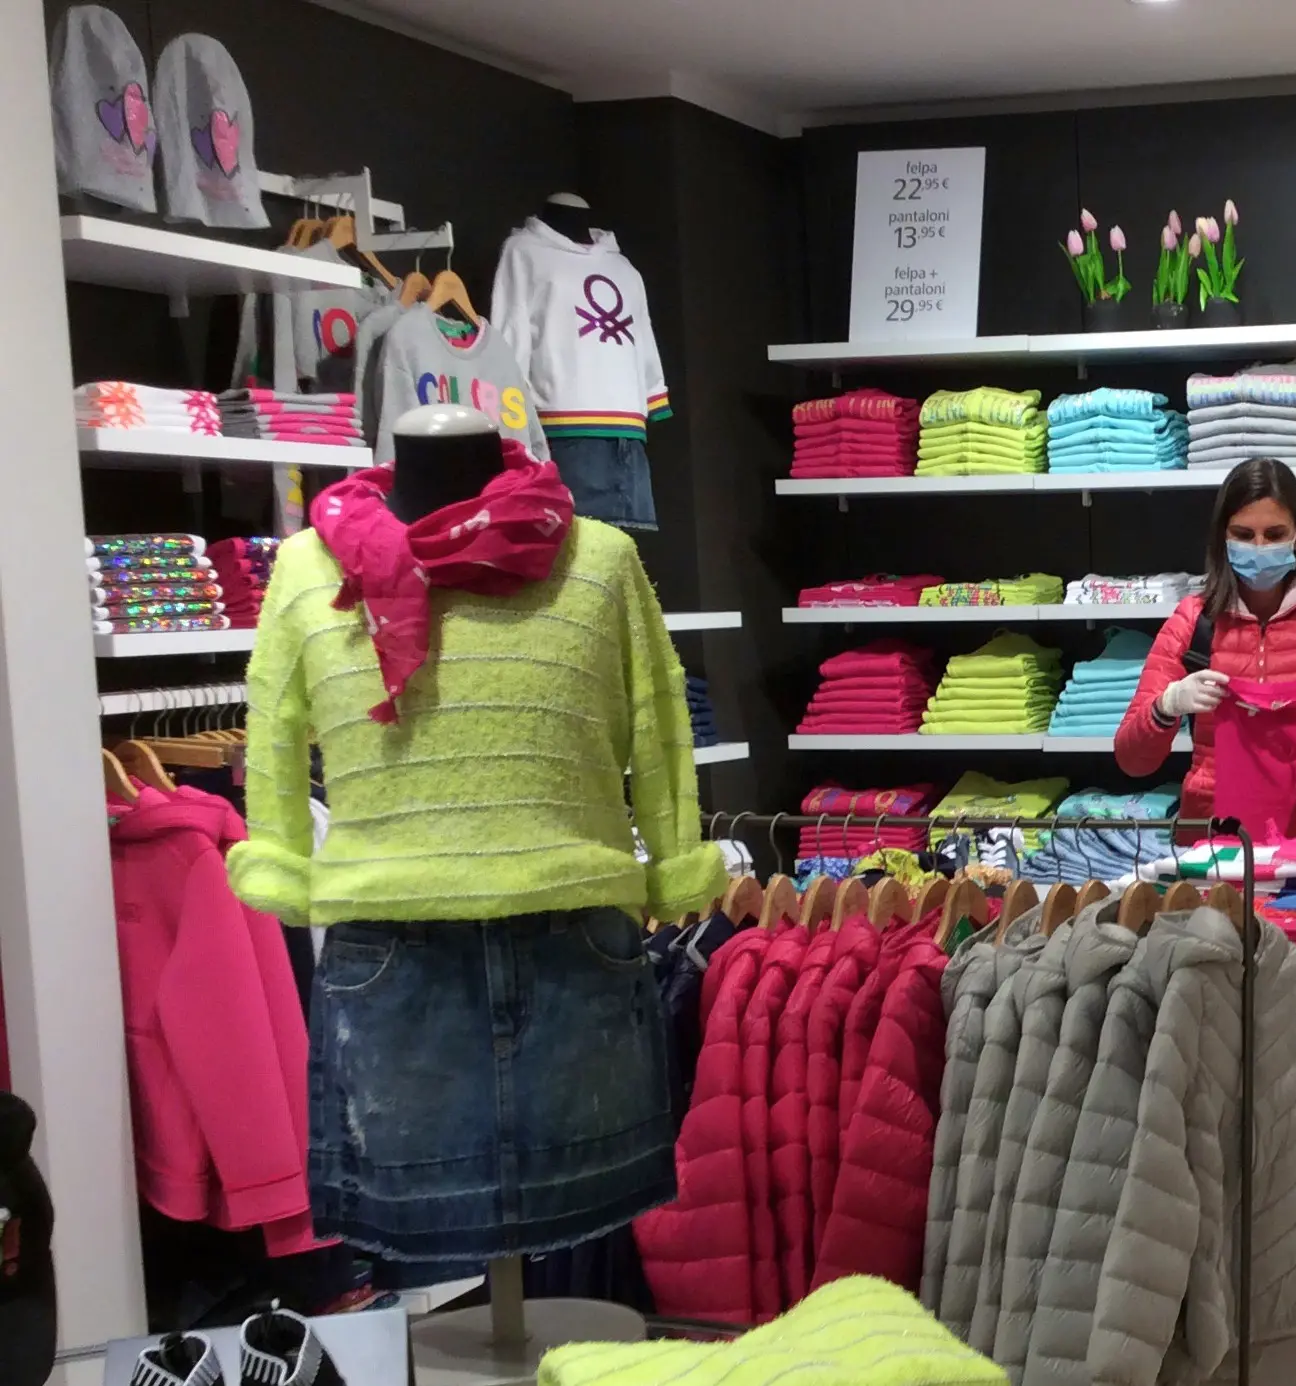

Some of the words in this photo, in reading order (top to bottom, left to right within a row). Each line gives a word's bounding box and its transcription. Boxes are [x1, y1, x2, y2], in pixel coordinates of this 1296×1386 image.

[906, 161, 938, 176] felpa
[892, 177, 940, 201] 22,95
[942, 178, 949, 190] €
[888, 208, 949, 226] pantaloni
[893, 226, 936, 249] 13,95
[938, 226, 945, 238] €
[894, 266, 926, 282] felpa
[929, 270, 938, 278] +
[884, 283, 945, 299] pantaloni
[885, 299, 933, 322] 29,95
[935, 299, 943, 311] €
